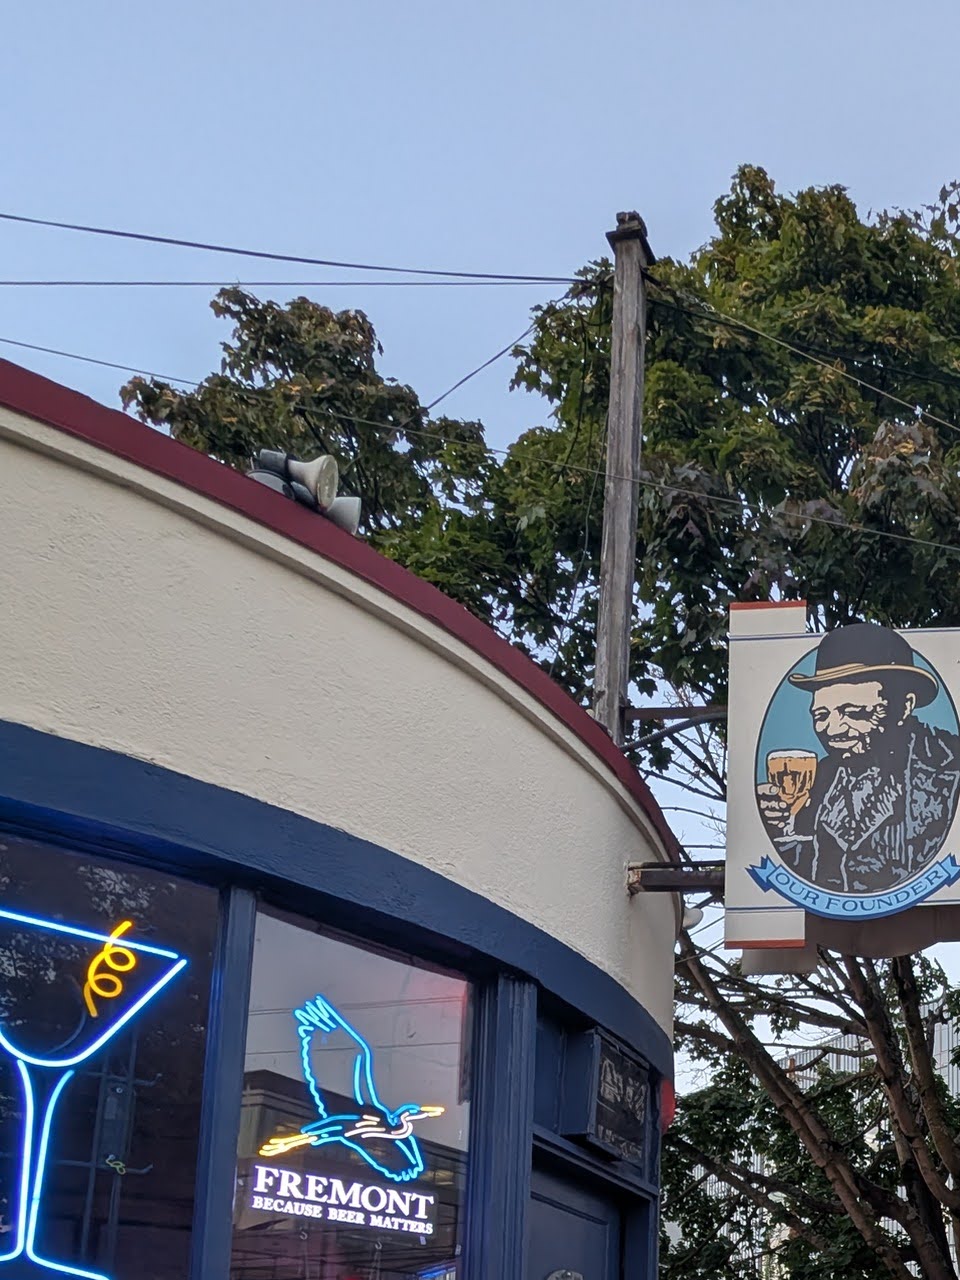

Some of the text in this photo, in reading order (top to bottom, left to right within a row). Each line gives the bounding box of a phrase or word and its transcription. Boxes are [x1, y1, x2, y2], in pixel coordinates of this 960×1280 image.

[774, 869, 945, 912] OUR FOUNDER
[253, 1165, 435, 1220] FREMONT
[252, 1196, 434, 1235] BECAUSE BEER MATTERS
